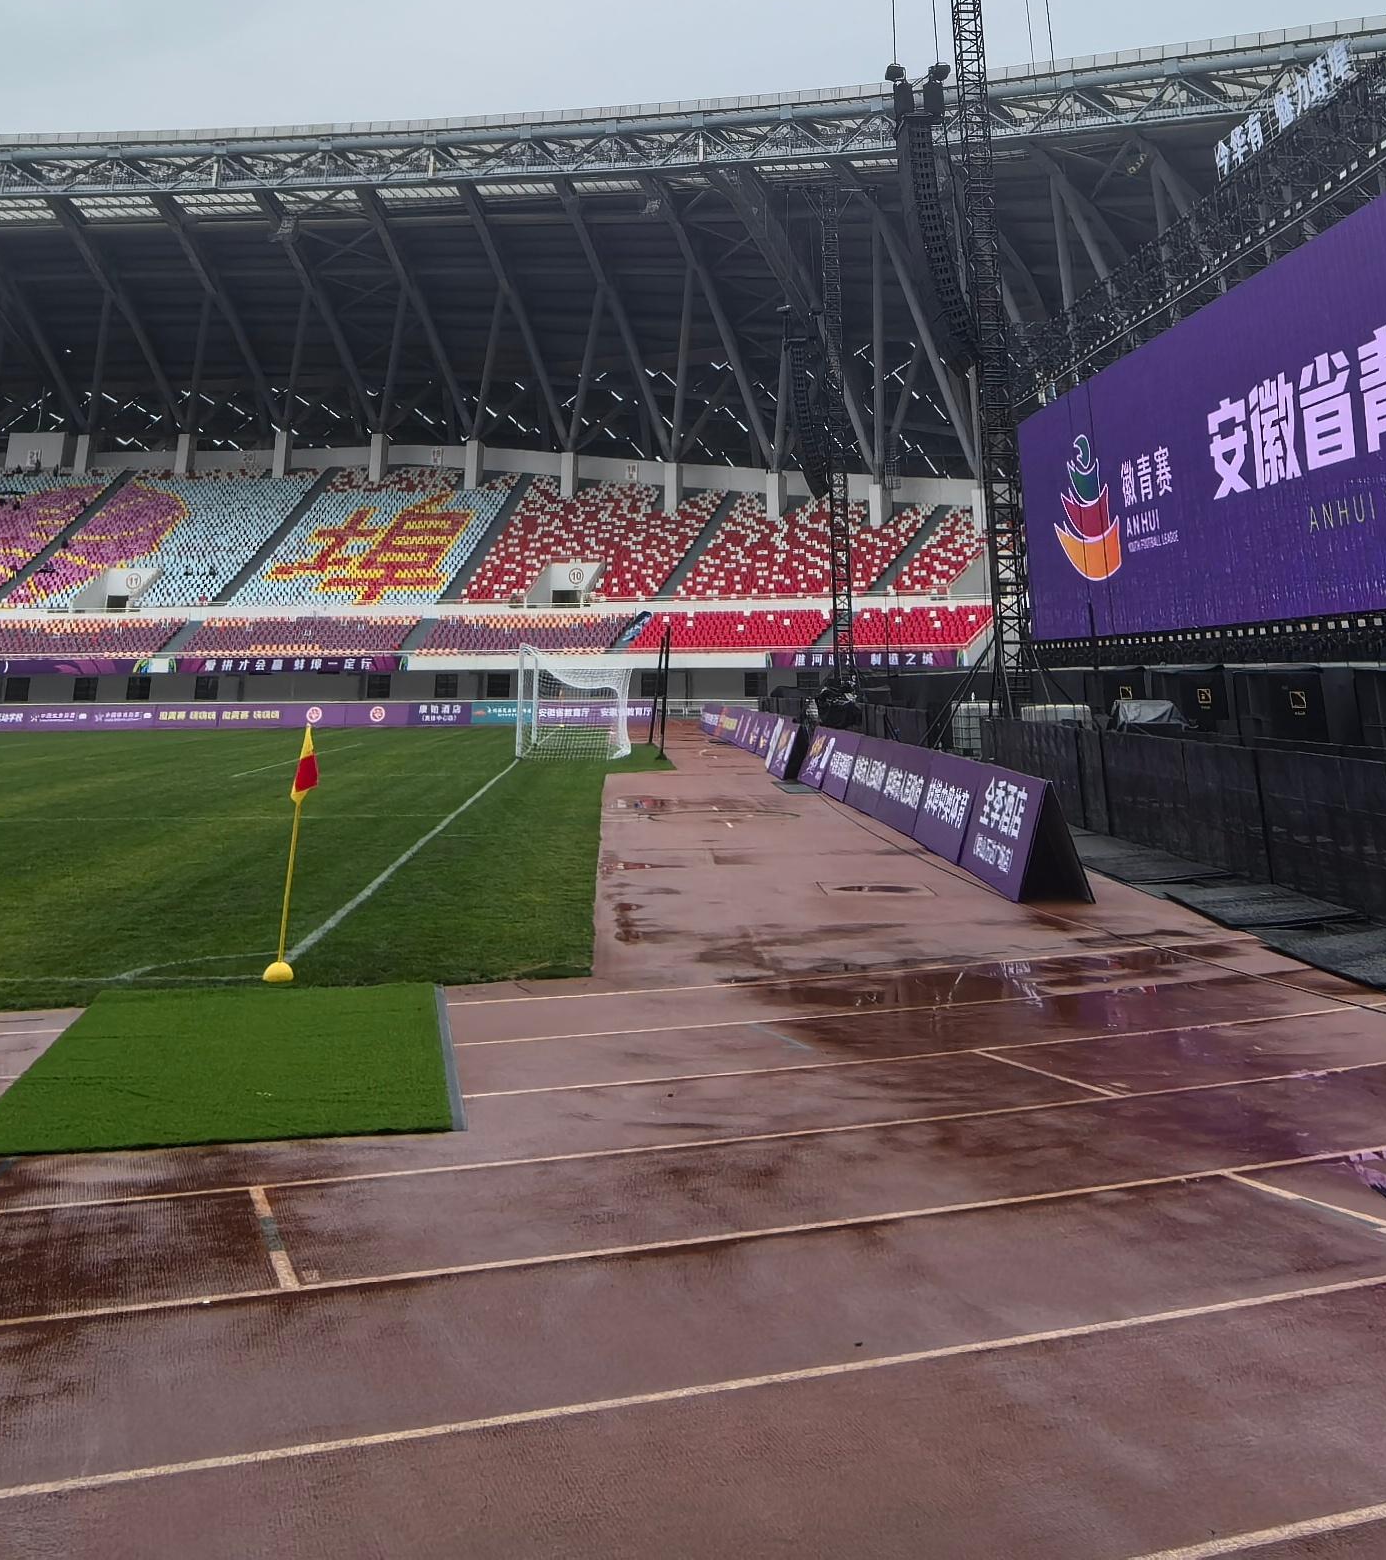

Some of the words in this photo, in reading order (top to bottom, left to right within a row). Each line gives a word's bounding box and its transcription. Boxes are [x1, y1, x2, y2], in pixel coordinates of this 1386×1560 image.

[1120, 445, 1173, 507] 徽青赛
[1126, 508, 1160, 537] ANHUI
[1309, 497, 1376, 533] ANHUI
[263, 490, 479, 606] 埠
[204, 658, 284, 671] 爱拼才会赢
[293, 657, 373, 671] 蚌埠一定行
[600, 706, 653, 717] 安徽教育厅
[979, 776, 1029, 840] 全季酒店
